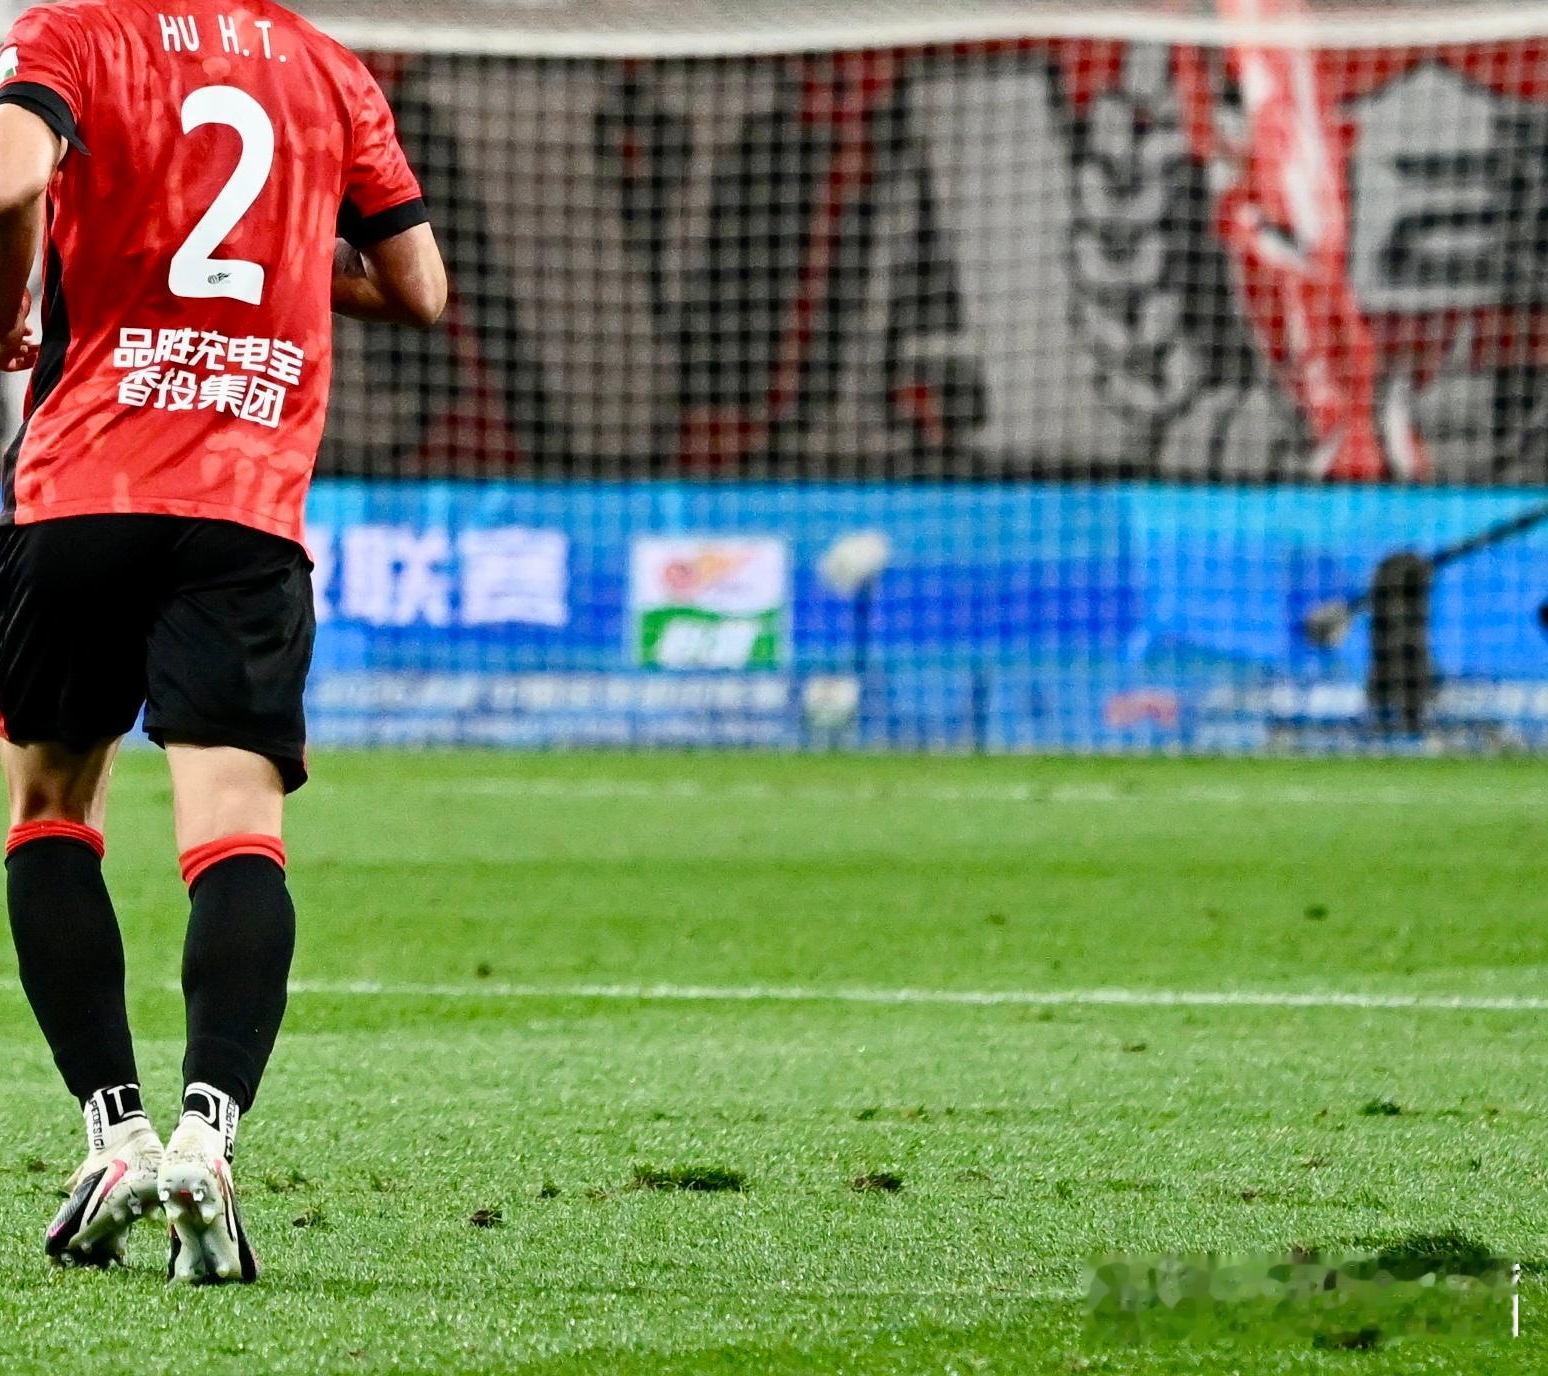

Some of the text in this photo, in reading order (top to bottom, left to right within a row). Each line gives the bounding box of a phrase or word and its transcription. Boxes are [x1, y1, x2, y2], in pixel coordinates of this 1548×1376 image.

[158, 13, 287, 63] HU H.T.
[168, 85, 274, 305] 2
[113, 327, 304, 386] 品胜充电宝
[117, 365, 288, 429] 香投集团
